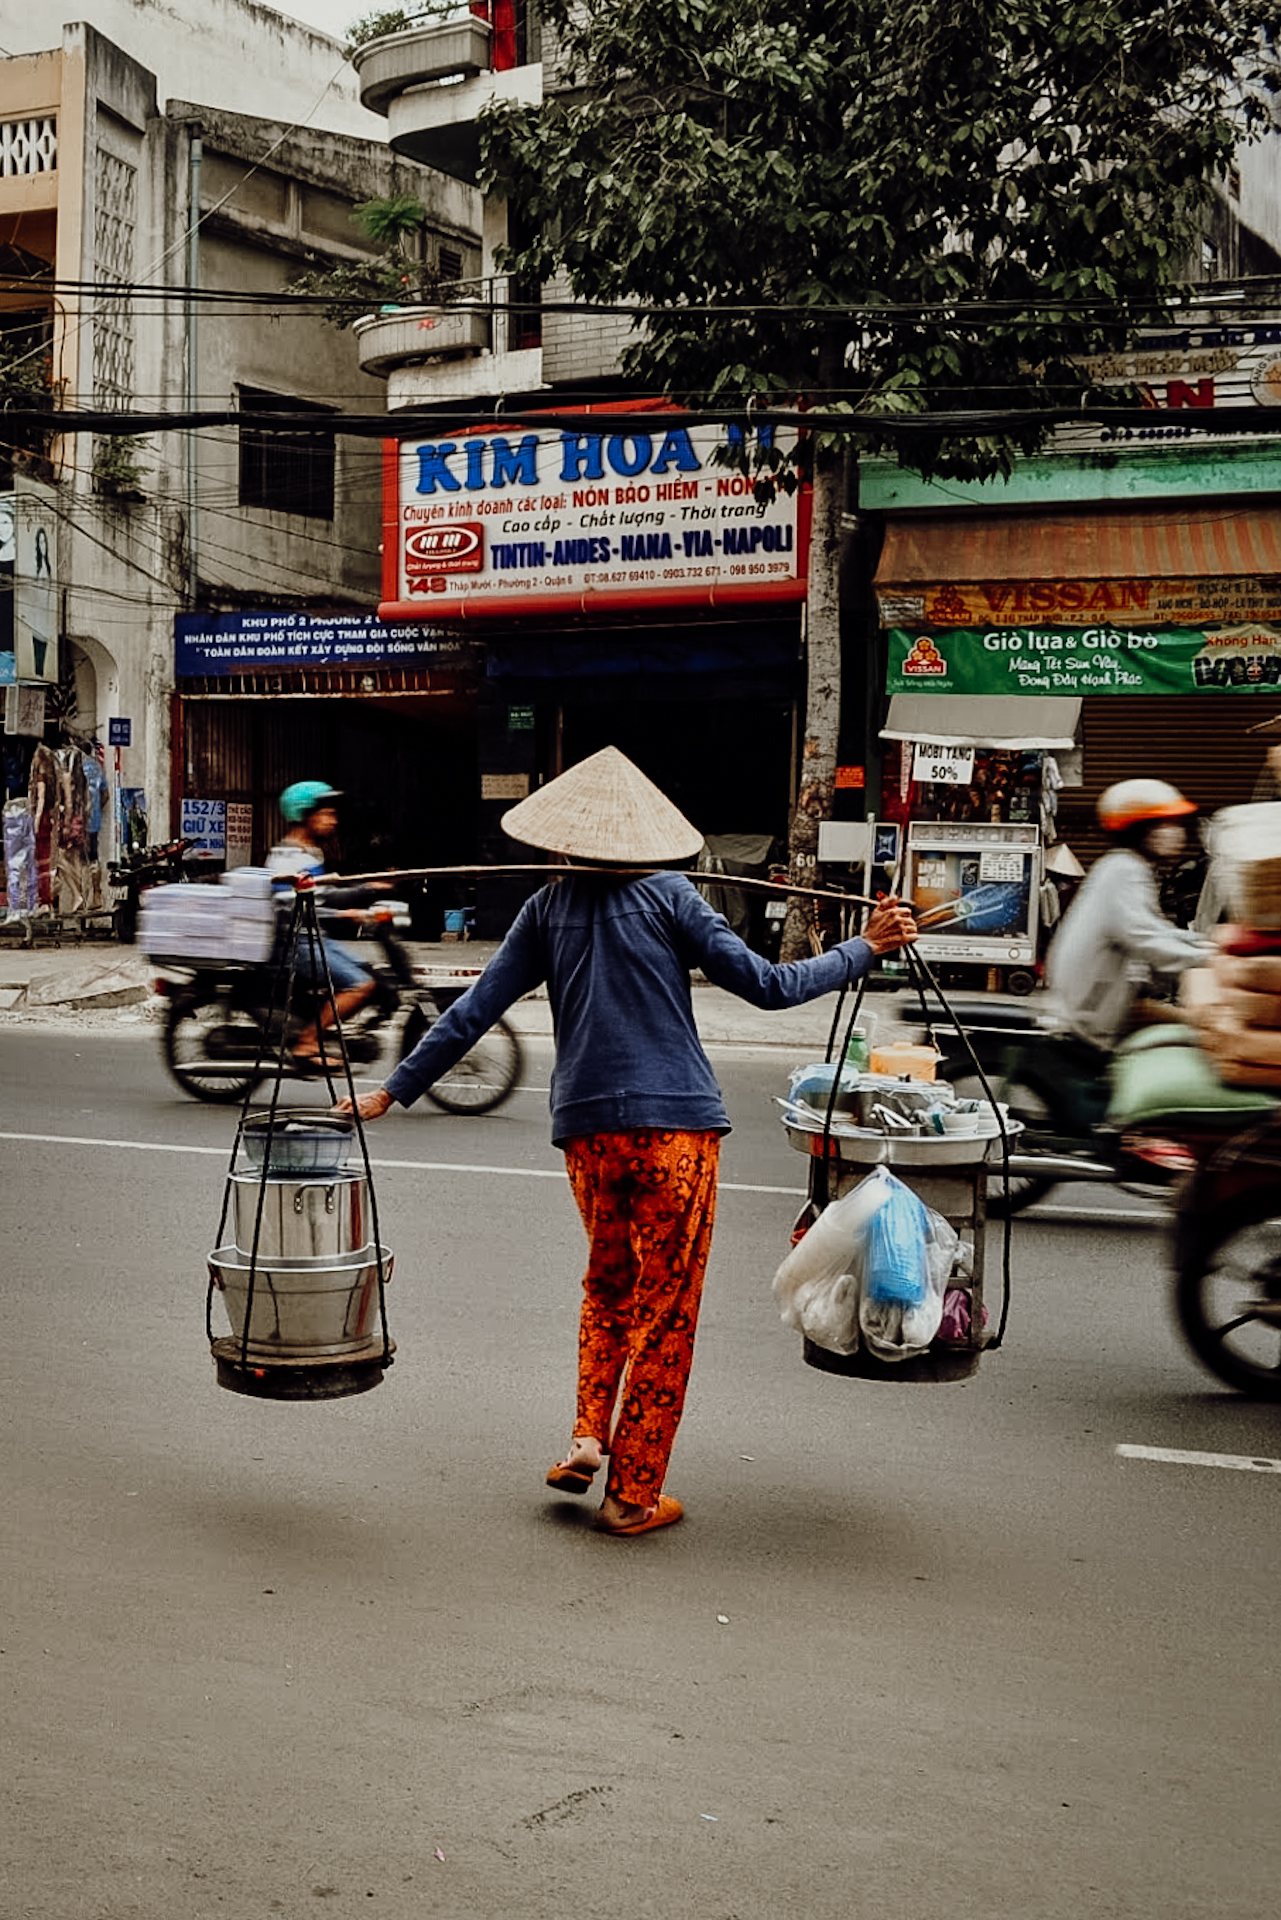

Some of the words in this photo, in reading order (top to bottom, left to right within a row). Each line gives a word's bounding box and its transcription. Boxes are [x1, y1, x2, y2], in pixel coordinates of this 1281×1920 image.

[416, 434, 540, 494] KIM
[559, 427, 703, 482] HOA
[403, 504, 444, 524] Chuyên
[448, 500, 473, 518] kinh
[476, 498, 513, 516] doanh
[517, 495, 537, 513] các
[540, 491, 567, 514] loại:
[572, 485, 609, 508] NÓN
[615, 481, 650, 505] BẢO
[656, 474, 698, 502] HIỂM
[502, 519, 530, 533] Cao
[580, 510, 616, 528] Chất
[619, 510, 666, 527] lượng
[681, 506, 716, 520] Thời
[721, 503, 768, 519] trang
[405, 577, 447, 594] 148
[532, 577, 538, 587] 2
[629, 570, 655, 582] 69410
[705, 566, 721, 577] 671
[729, 564, 746, 575] 098
[767, 562, 790, 573] 3979
[978, 581, 1151, 612] VISSAN
[242, 617, 267, 628] KHU
[270, 614, 297, 627] PHỐ
[298, 616, 306, 626] 2
[184, 632, 213, 644] NHÂN
[215, 632, 237, 644] DÂN
[238, 632, 261, 643] KHU
[263, 629, 285, 642] PHỐ
[287, 628, 311, 641] TÍCH
[337, 629, 367, 640] THAM
[369, 628, 388, 639] GIA
[390, 626, 419, 640] CUỘC
[983, 632, 1023, 651] Giò
[1027, 631, 1063, 655] lụa
[1065, 635, 1078, 649] &
[1081, 629, 1121, 649] Giò
[1128, 631, 1158, 649] bò
[232, 645, 255, 657] DÂN
[256, 644, 285, 657] ĐOÀN
[287, 642, 309, 655] KẾT
[311, 642, 331, 655] XÂY
[387, 640, 415, 654] SỐNG
[906, 665, 942, 673] VISSAN
[919, 744, 944, 759] MOBI
[931, 765, 959, 780] 50%
[183, 801, 226, 815] 152/3
[183, 816, 207, 833] GIỮ
[209, 820, 226, 833] XE
